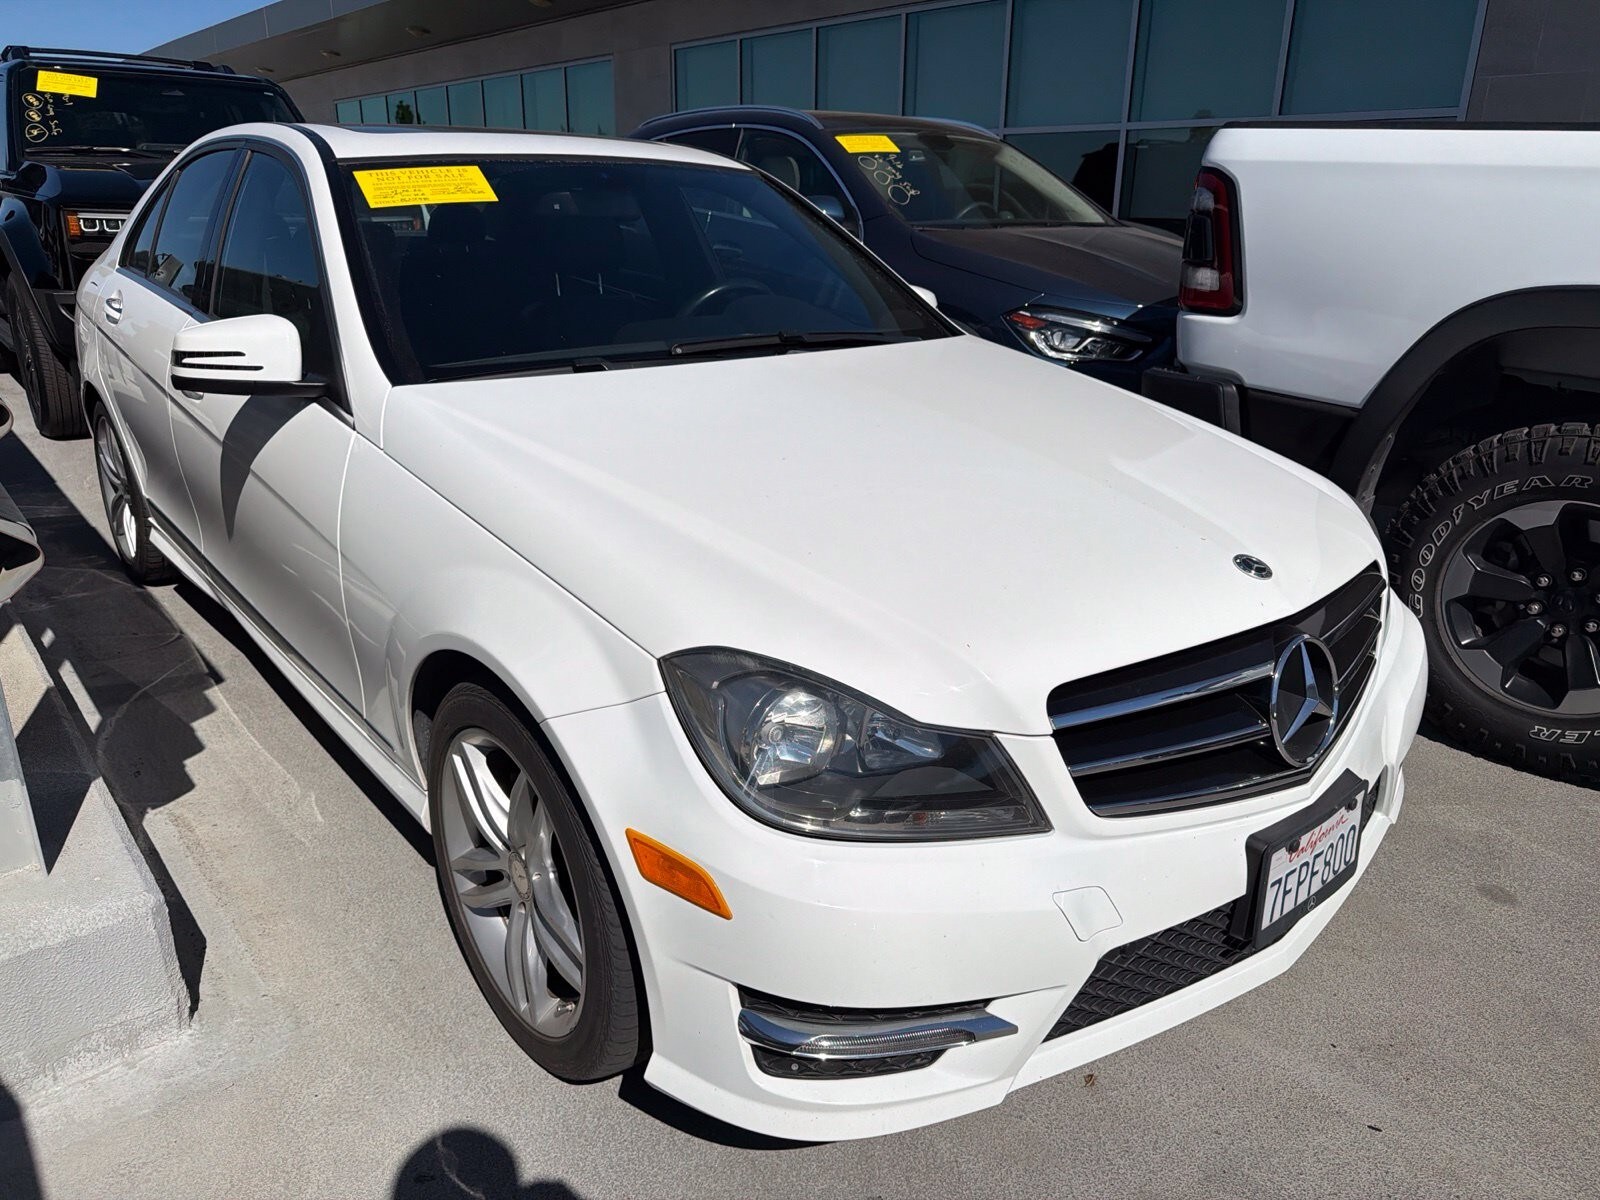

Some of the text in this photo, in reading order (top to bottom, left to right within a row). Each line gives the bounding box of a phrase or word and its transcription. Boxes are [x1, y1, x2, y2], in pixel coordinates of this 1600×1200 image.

[367, 170, 396, 178] THIS
[1408, 474, 1593, 618] GOODYEAR
[1269, 824, 1357, 923] 7FPF800
[1288, 812, 1349, 862] California
